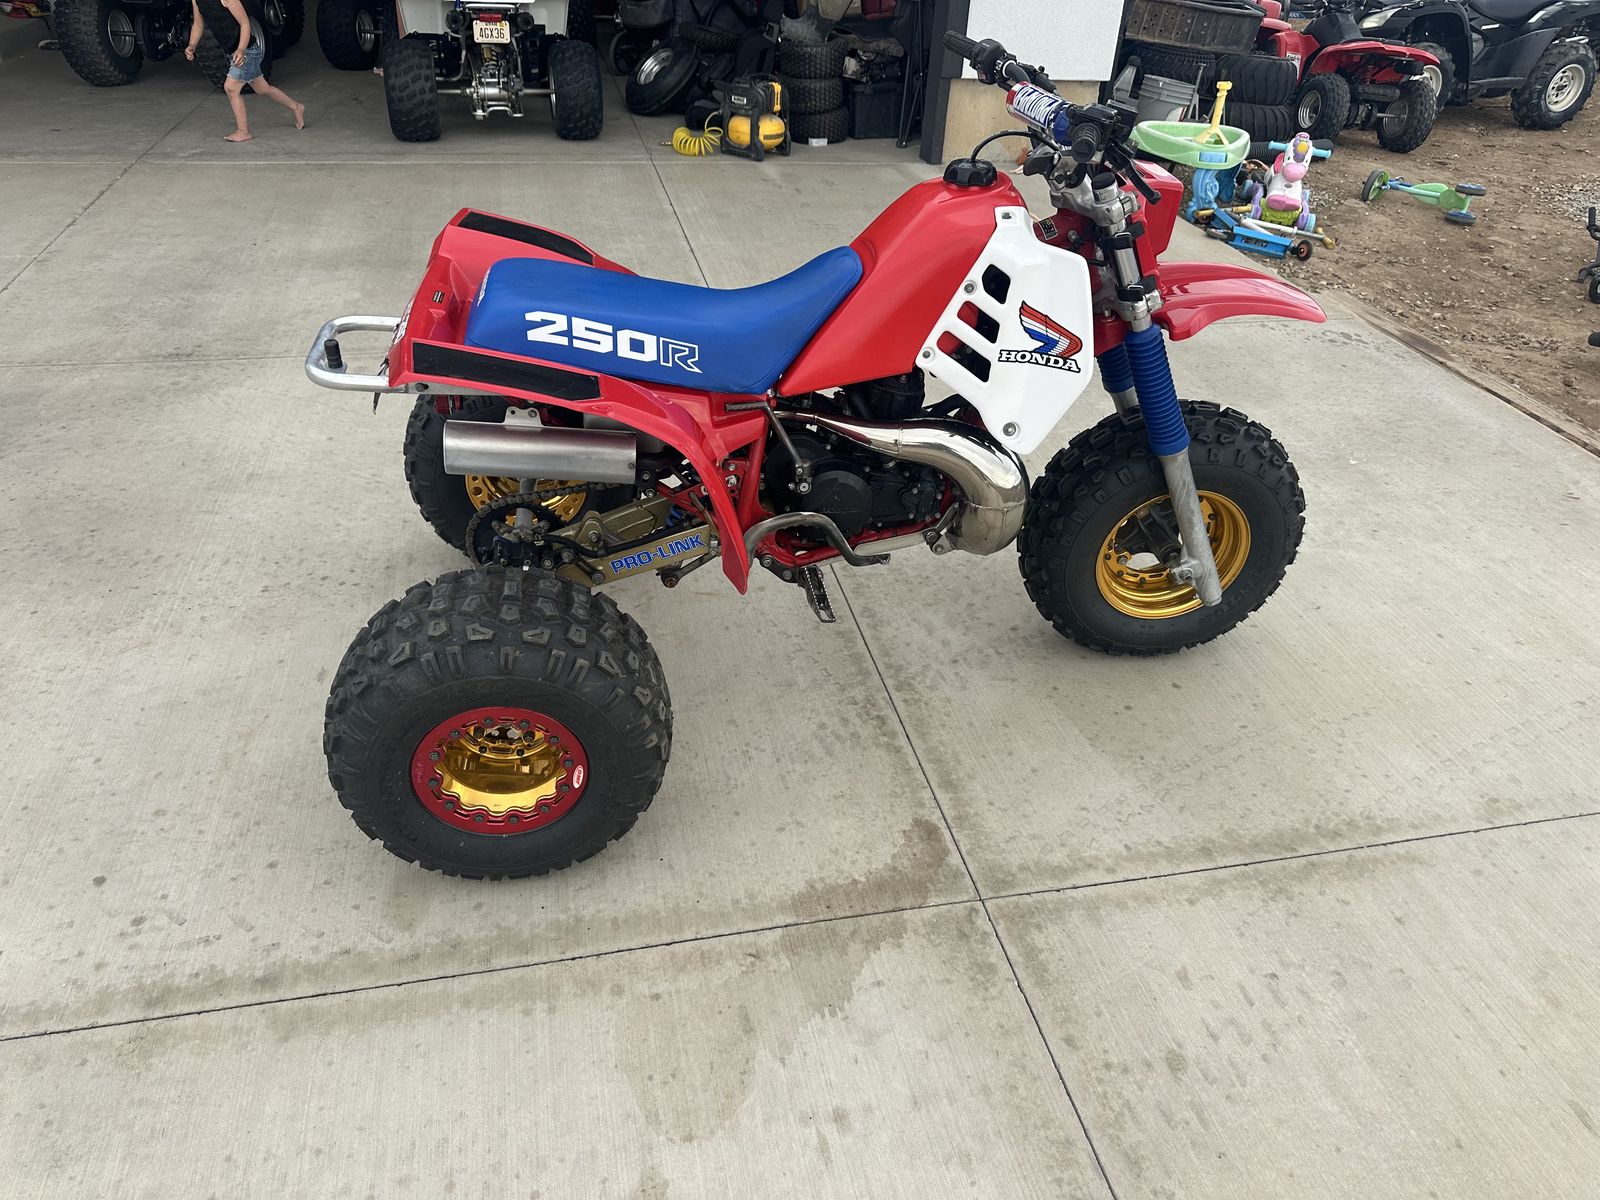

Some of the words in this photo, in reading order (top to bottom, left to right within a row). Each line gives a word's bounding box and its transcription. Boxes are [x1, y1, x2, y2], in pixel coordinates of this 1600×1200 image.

[479, 27, 505, 39] 4GX36
[524, 310, 703, 374] 250R
[999, 350, 1081, 373] HONDA
[610, 533, 707, 575] PRO-LINK
